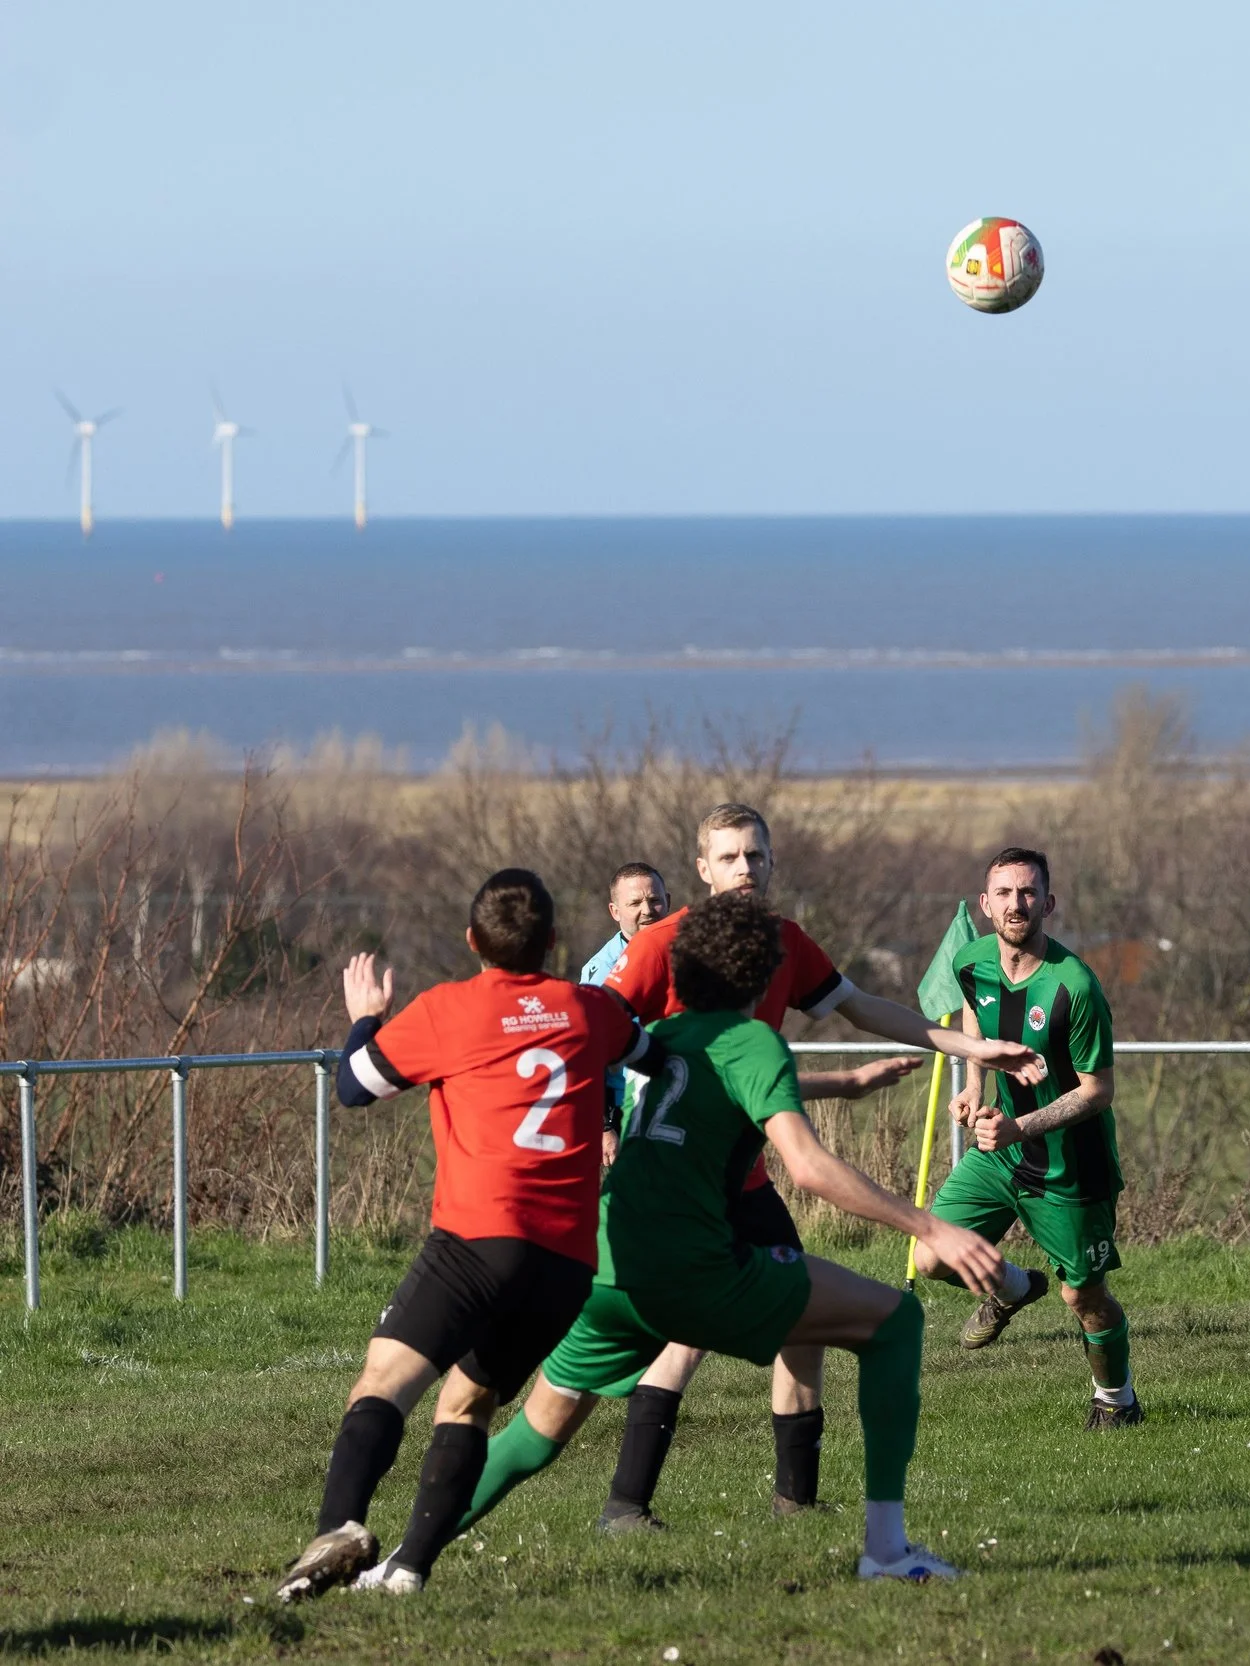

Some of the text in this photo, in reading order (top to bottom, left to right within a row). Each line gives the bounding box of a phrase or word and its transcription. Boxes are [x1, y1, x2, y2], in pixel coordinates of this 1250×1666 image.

[501, 1011, 569, 1026] RG HOWELLS
[513, 1047, 567, 1153] 2
[624, 1055, 688, 1146] 12
[1086, 1240, 1110, 1262] 19
